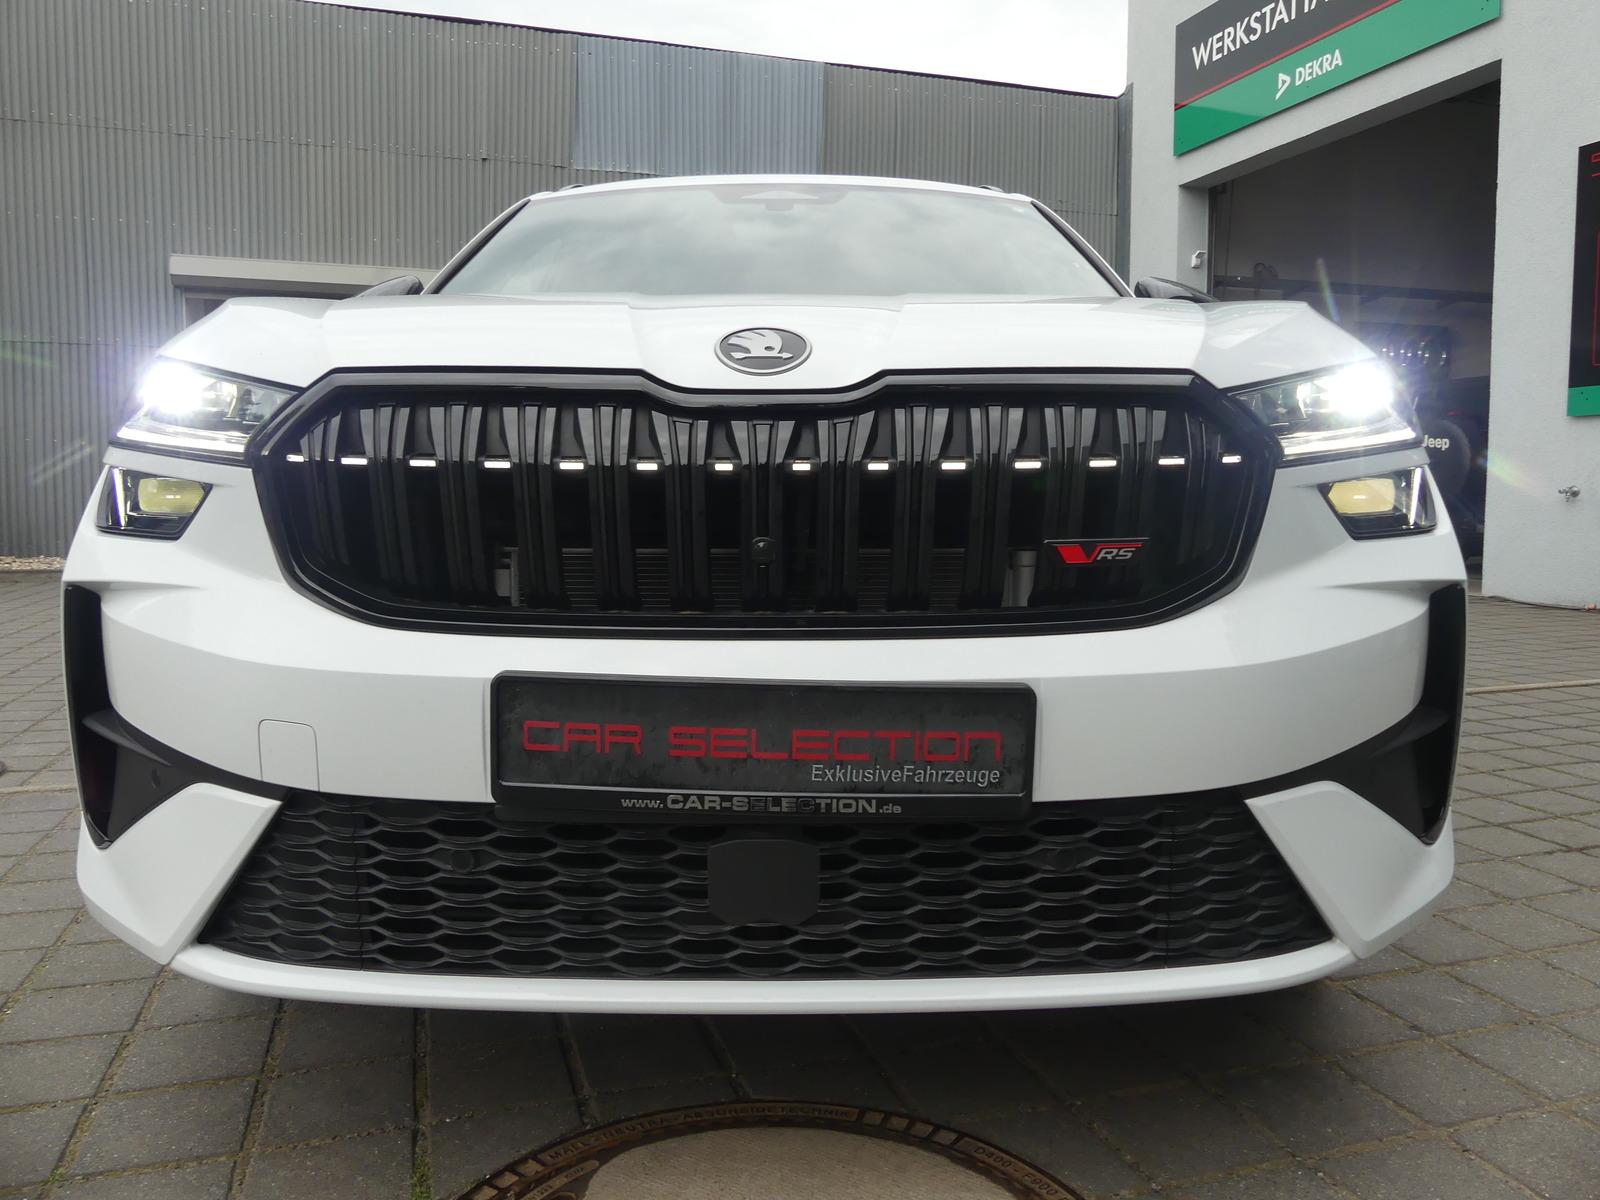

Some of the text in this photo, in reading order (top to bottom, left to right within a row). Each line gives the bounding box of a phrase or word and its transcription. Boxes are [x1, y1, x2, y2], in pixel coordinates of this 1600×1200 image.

[1191, 0, 1329, 70] WERKSTAT
[1295, 49, 1343, 87] DEKRA
[1423, 434, 1450, 451] Jeep
[522, 720, 1003, 762] CAR SELECTION
[811, 763, 1001, 787] ExklusiveFahrzeuge
[621, 794, 902, 815] www.CAR-SELECTION.de
